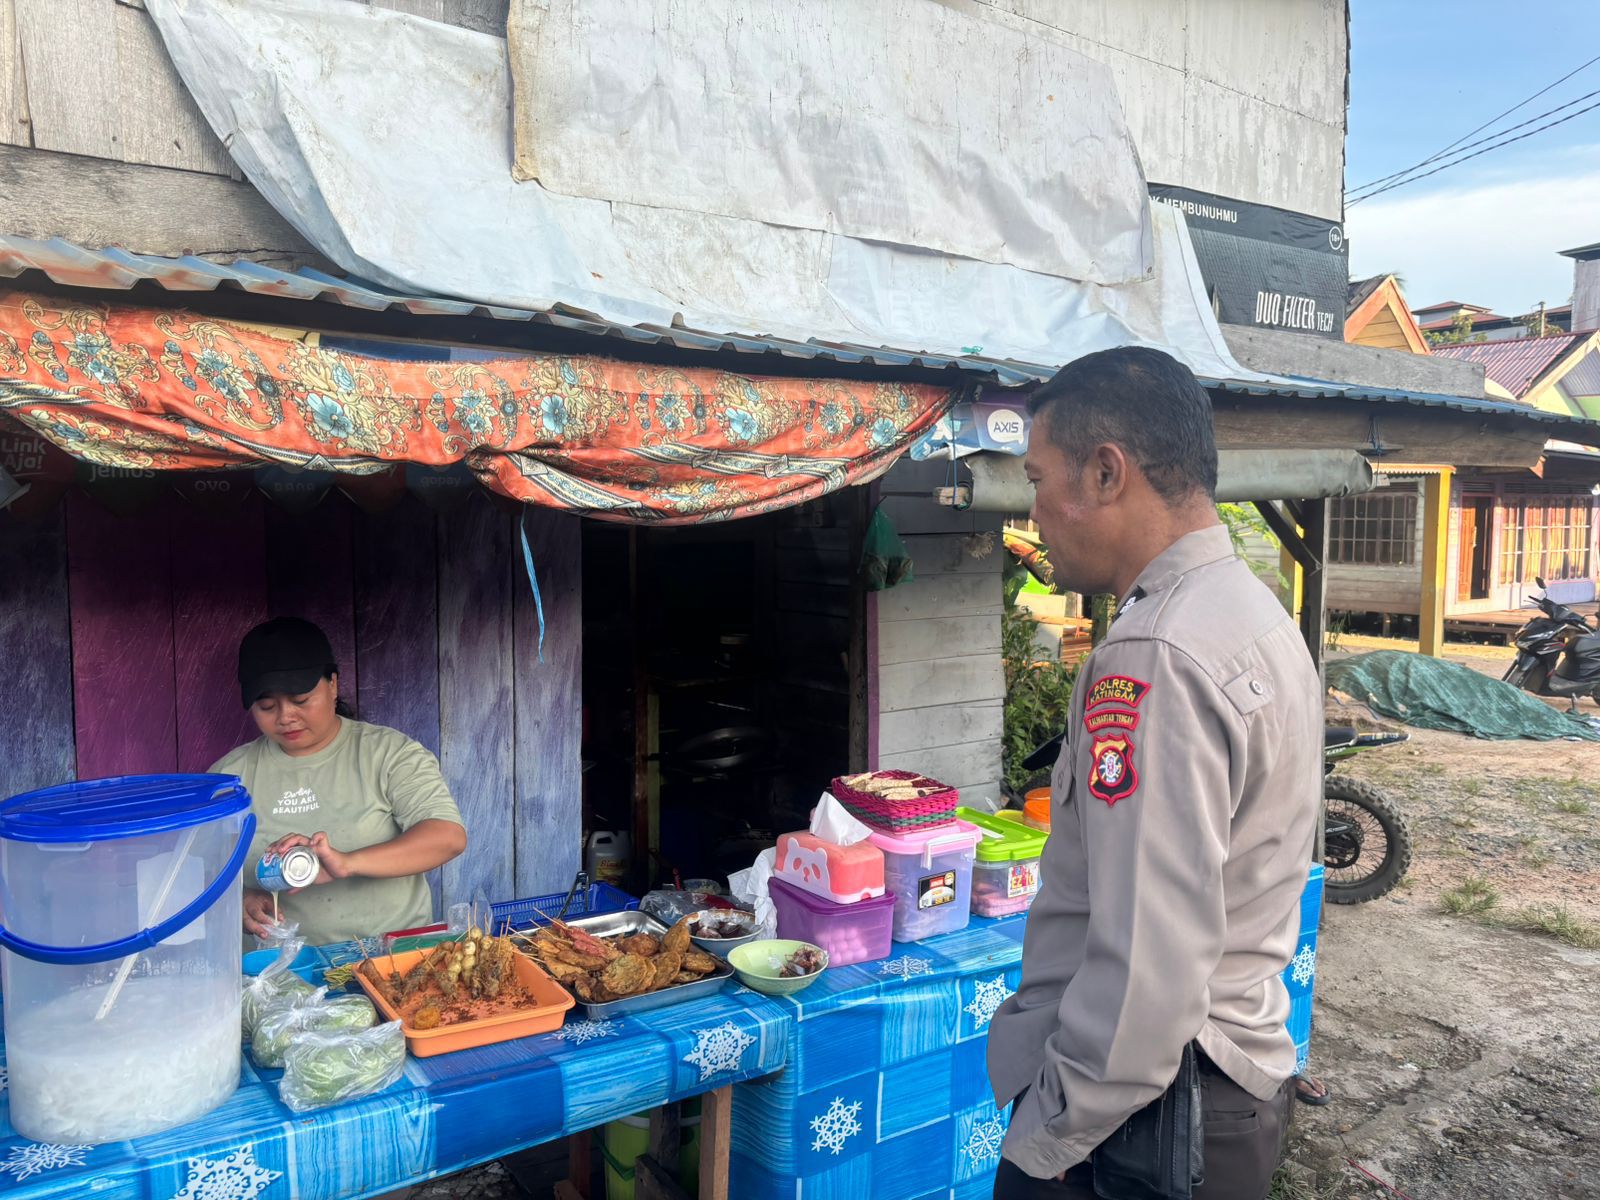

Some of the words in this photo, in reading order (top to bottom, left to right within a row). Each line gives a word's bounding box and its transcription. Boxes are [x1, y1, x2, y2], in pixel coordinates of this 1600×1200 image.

[1255, 291, 1282, 324] DUO
[1282, 295, 1316, 330] FILTER
[1316, 312, 1335, 332] TECH
[993, 421, 1019, 434] AXIS
[1, 437, 47, 455] Link
[4, 454, 43, 472] Aja!
[1093, 678, 1135, 695] POLRES
[1089, 689, 1137, 705] KATINGAN
[277, 798, 298, 806] YOU
[300, 794, 317, 805] ARE
[272, 802, 321, 815] BEAUTIFUL
